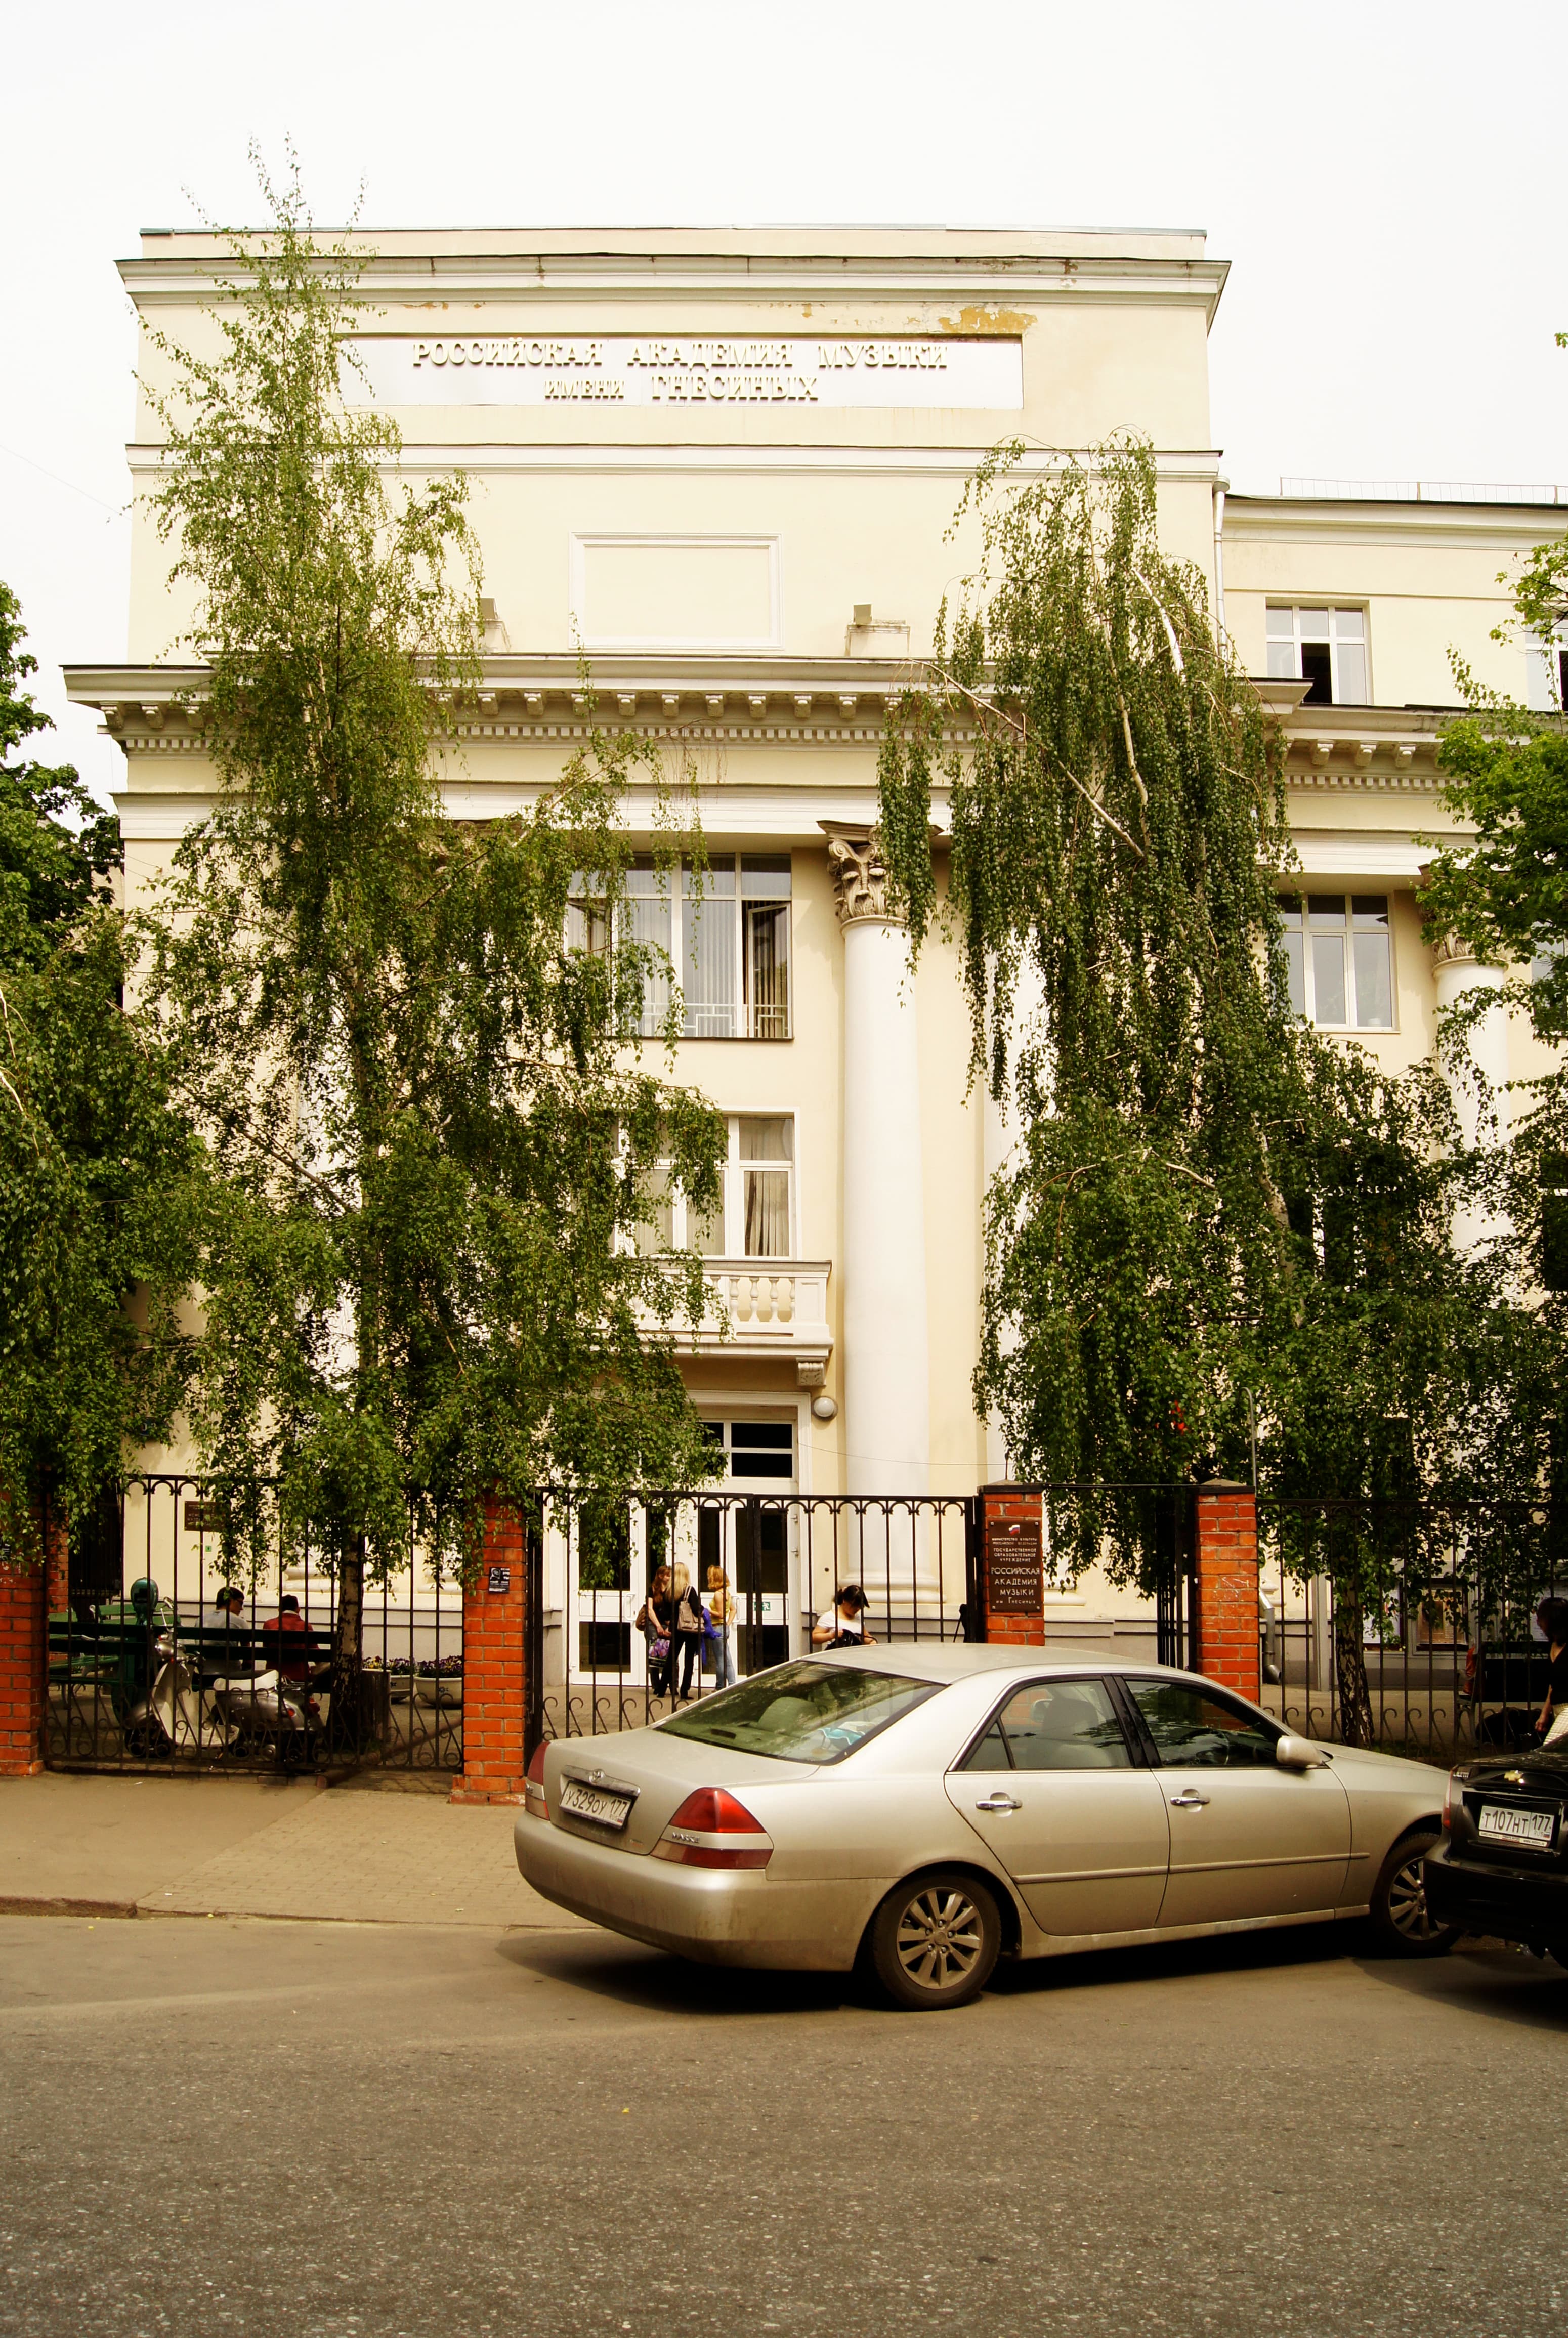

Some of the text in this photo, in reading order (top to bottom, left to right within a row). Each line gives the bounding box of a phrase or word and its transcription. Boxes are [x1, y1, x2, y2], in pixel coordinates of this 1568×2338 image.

[413, 337, 948, 372] РОССИЙСКАЯ АКАДЕМИЯ МУЗЫКИ
[544, 376, 819, 401] ИМЕНИ ГНЕСИНЫХ
[611, 1799, 628, 1816] 177
[1532, 1814, 1551, 1832] 177
